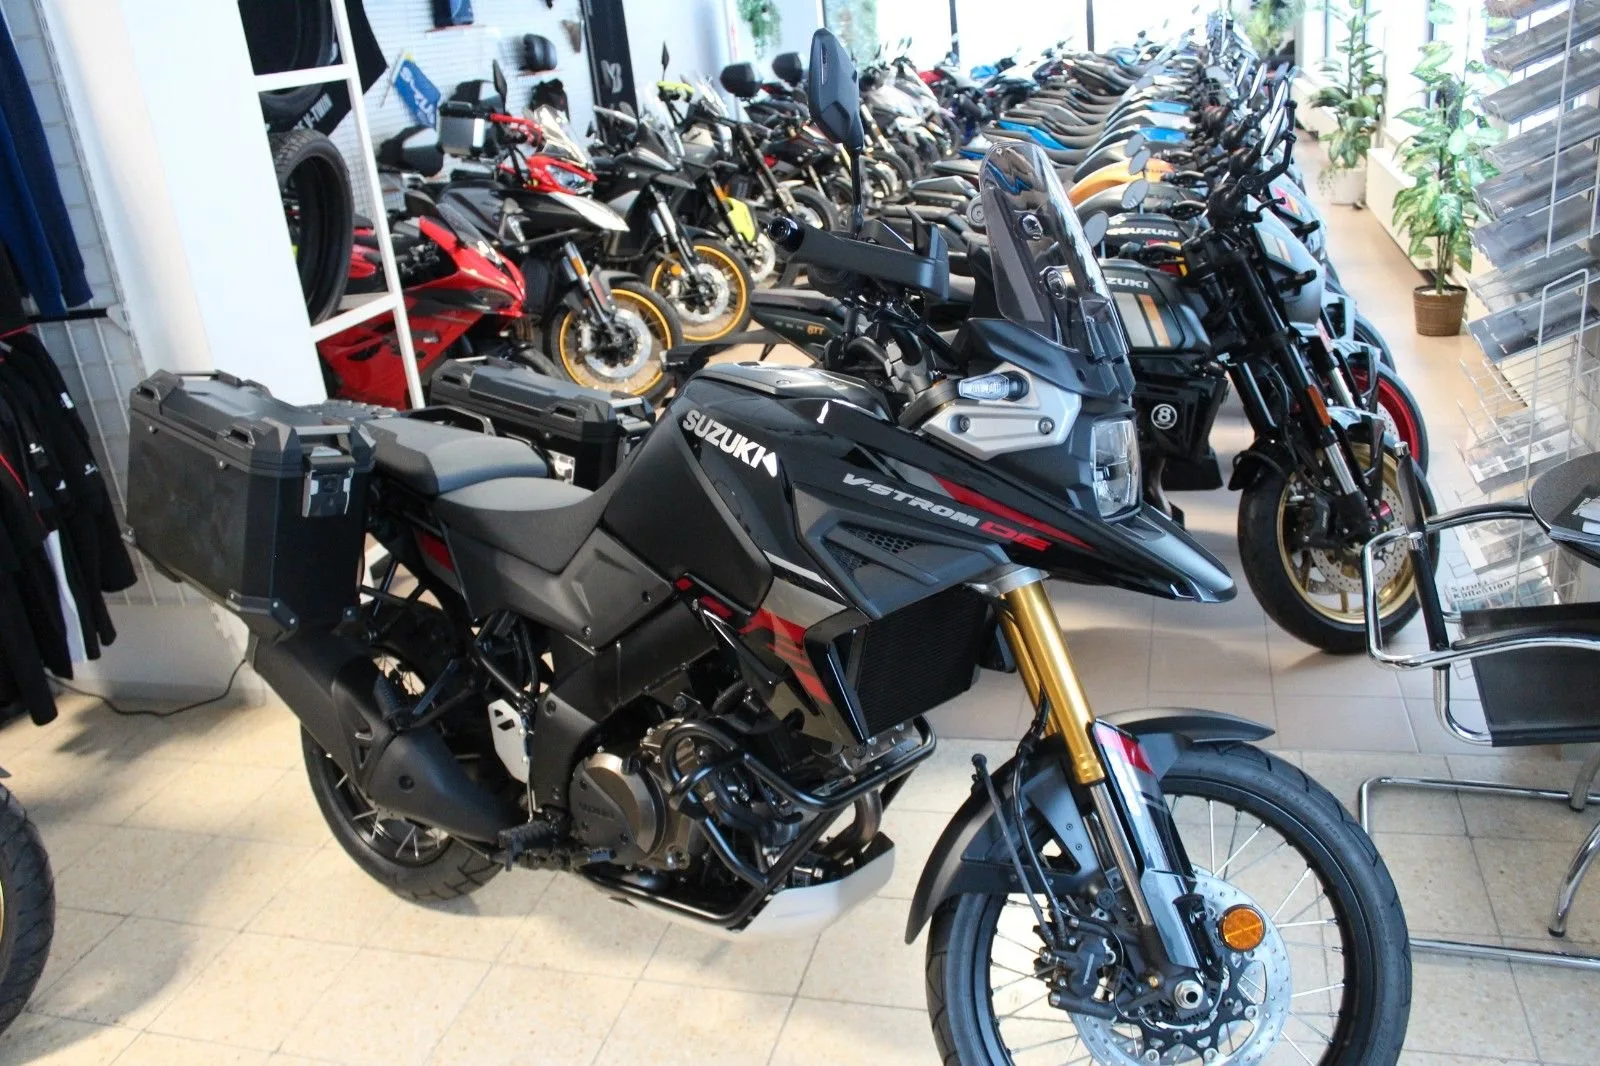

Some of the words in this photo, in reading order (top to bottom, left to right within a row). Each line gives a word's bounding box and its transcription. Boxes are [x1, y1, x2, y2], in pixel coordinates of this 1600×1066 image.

[1105, 277, 1149, 289] ZUKI
[683, 409, 767, 469] SUZUKI
[842, 473, 980, 527] V-STROM
